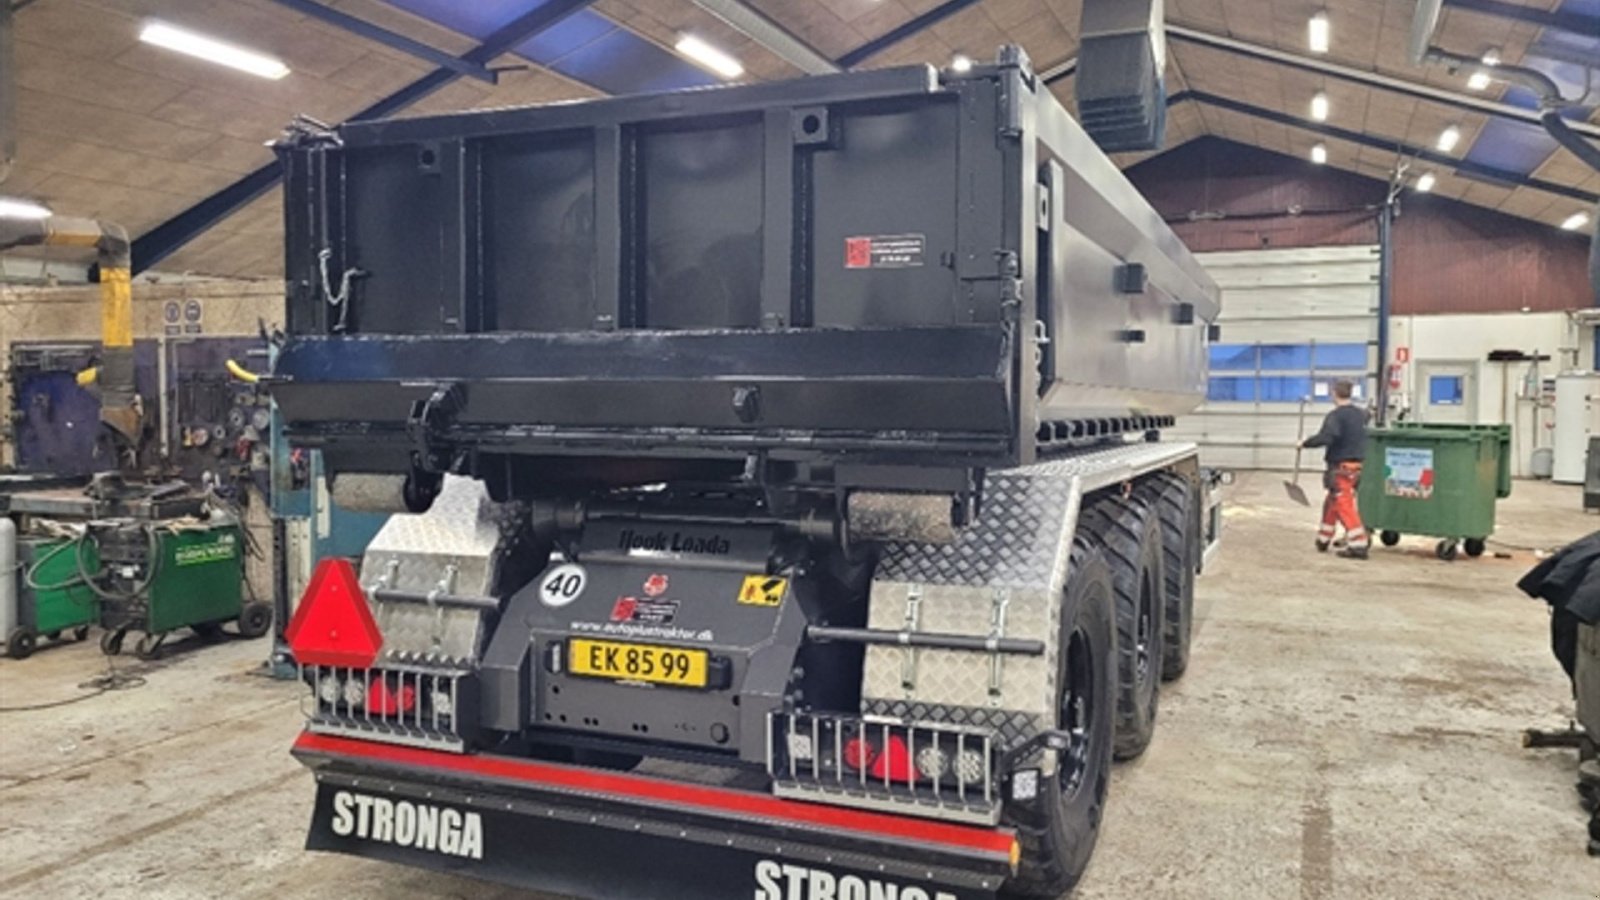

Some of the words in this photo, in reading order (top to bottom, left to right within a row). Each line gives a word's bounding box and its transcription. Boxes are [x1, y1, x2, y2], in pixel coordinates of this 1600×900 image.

[618, 529, 667, 552] Hook
[669, 532, 731, 555] Loada
[544, 573, 581, 597] 40
[589, 645, 619, 672] EK
[626, 648, 654, 675] 85
[660, 652, 689, 680] 99
[332, 790, 484, 860] STRONGA
